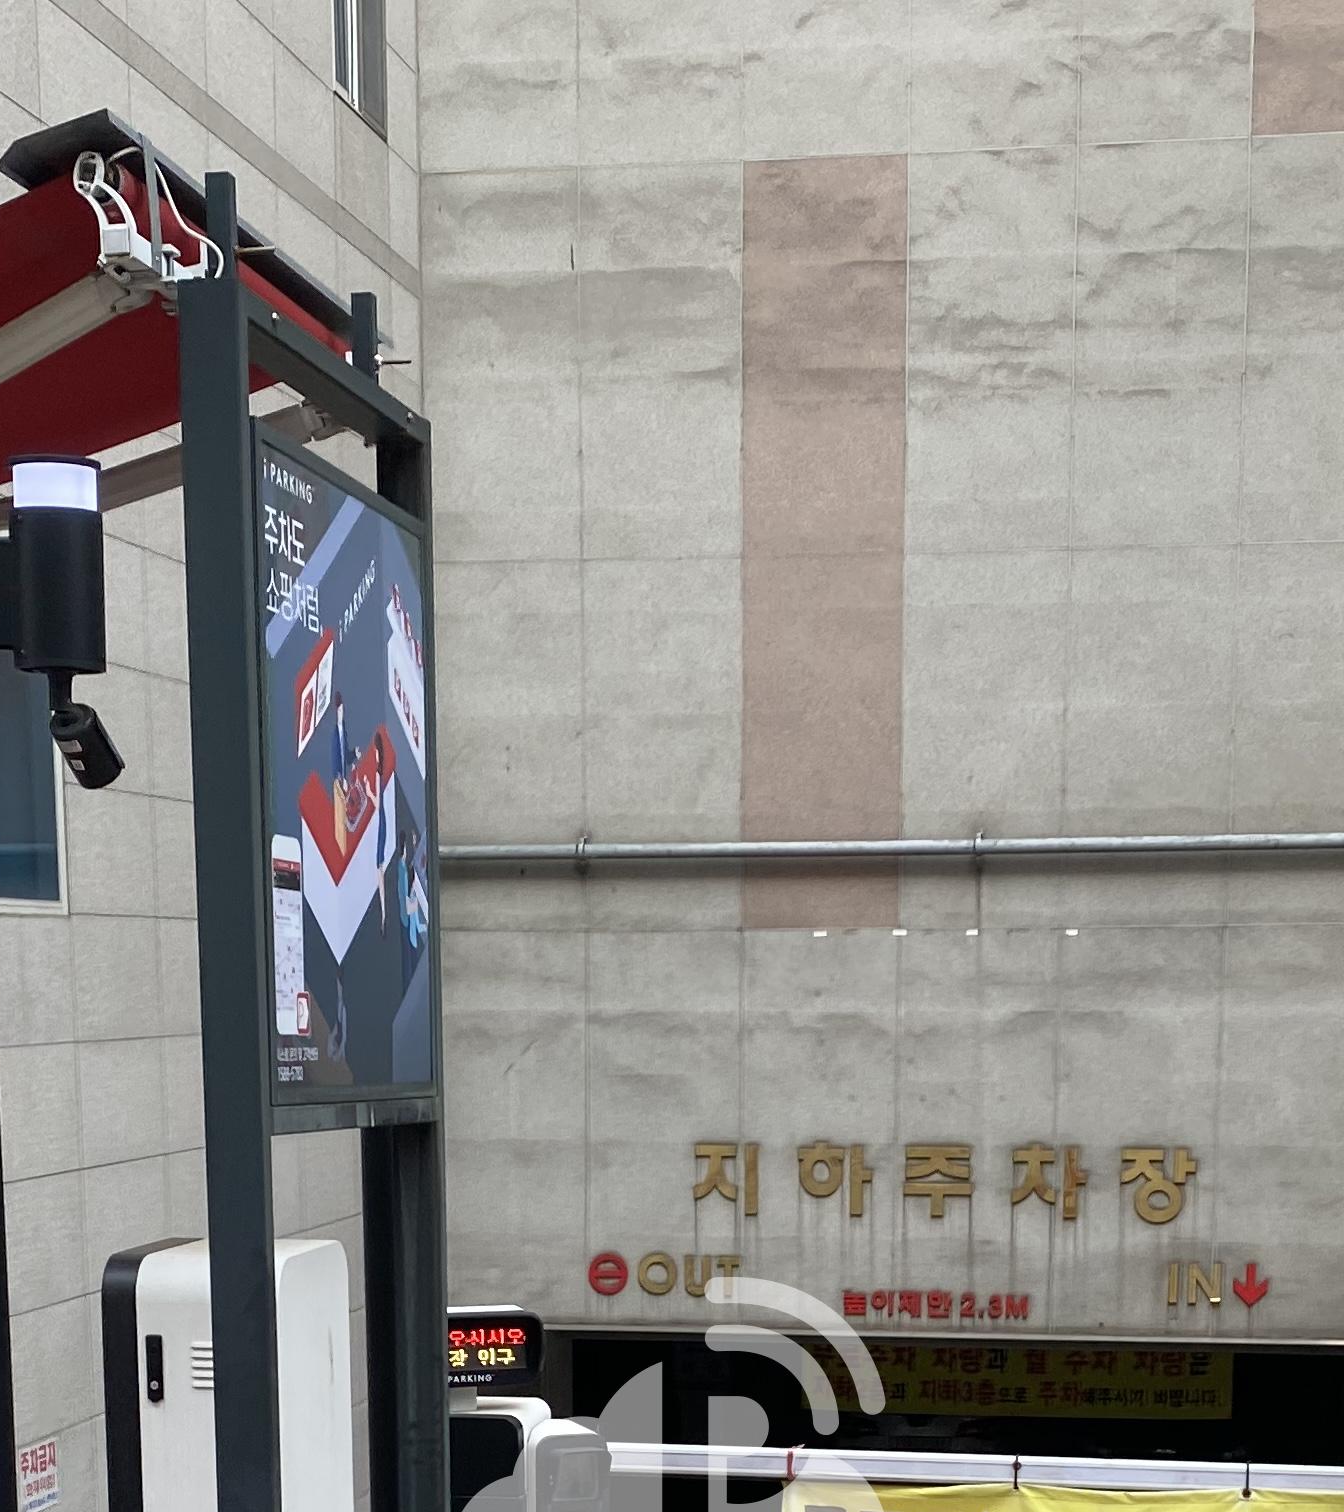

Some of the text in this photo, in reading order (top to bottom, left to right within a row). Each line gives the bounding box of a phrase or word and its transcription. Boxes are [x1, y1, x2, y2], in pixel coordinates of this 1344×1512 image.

[270, 463, 313, 505] PARKING
[264, 504, 306, 567] 주차도
[693, 1141, 1198, 1225] 지하주차장
[637, 1252, 743, 1297] OUT
[1167, 1262, 1223, 1307] IN
